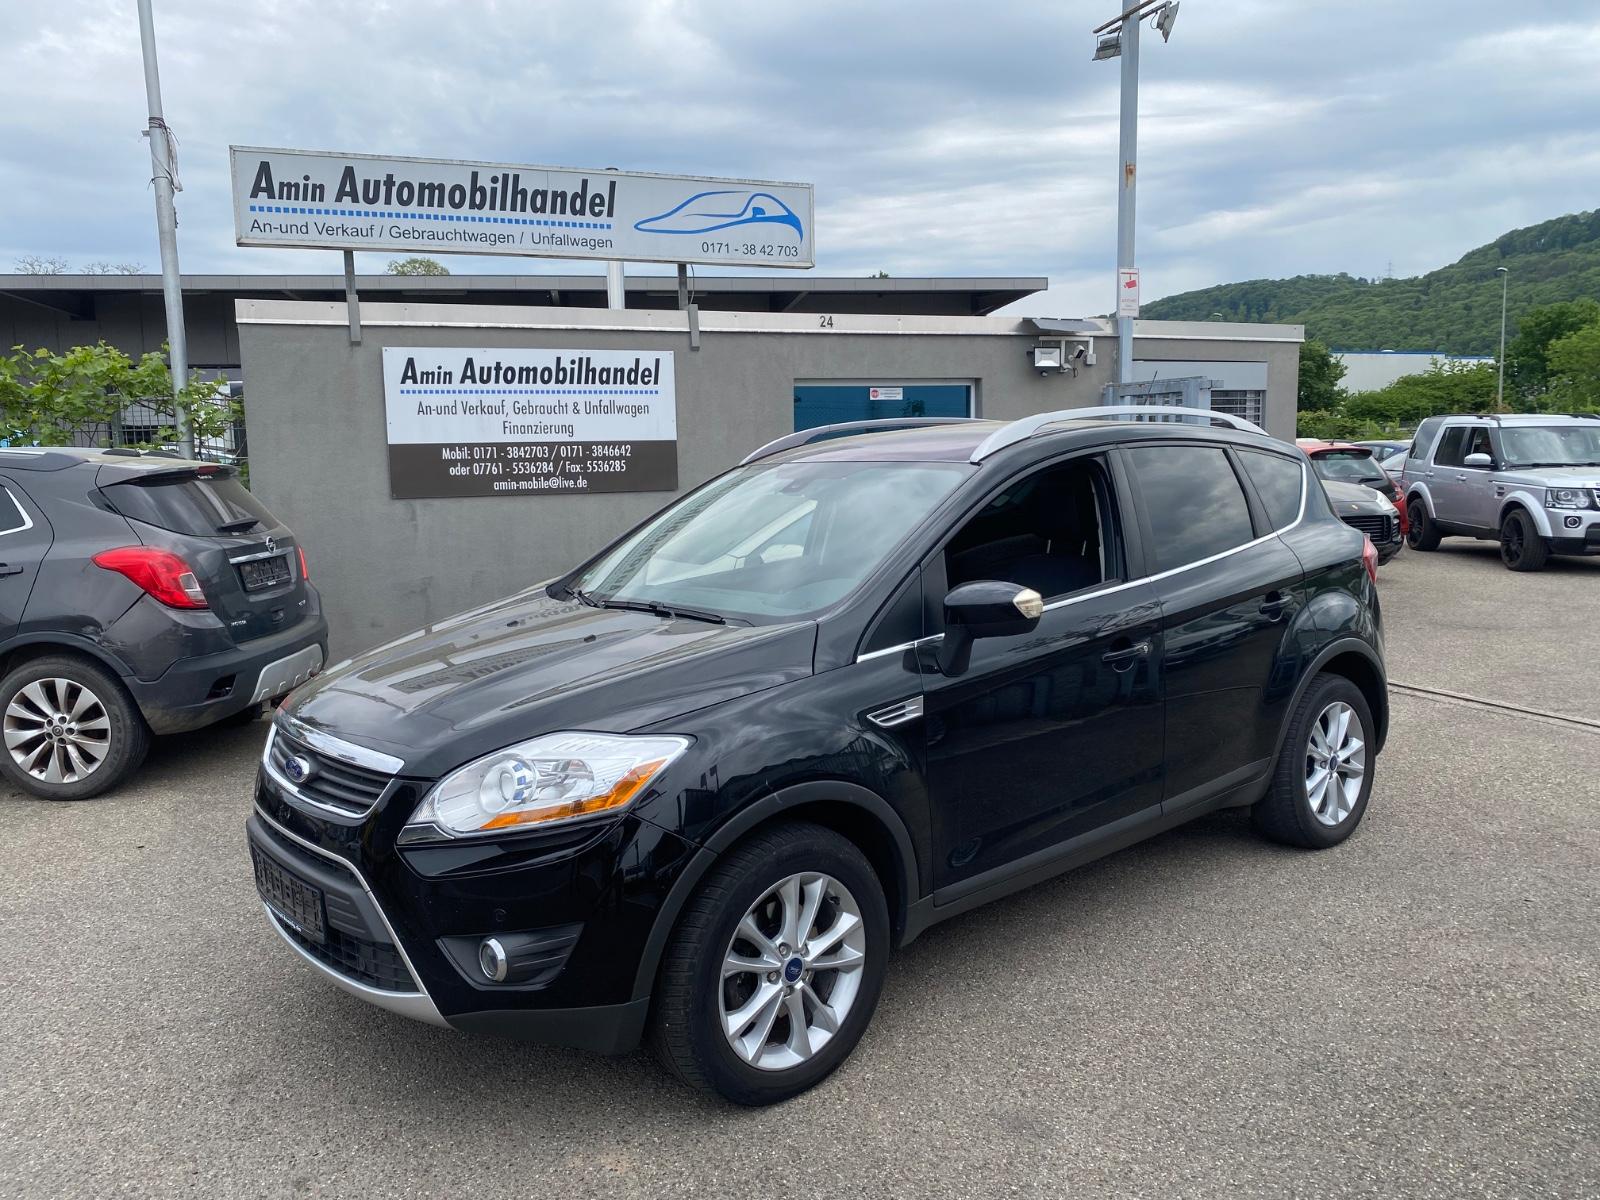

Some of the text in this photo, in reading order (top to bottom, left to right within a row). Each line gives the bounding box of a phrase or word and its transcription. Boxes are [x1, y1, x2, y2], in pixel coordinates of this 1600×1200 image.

[250, 161, 617, 218] Amin Automobilhandel
[250, 219, 613, 250] An-und Verkauf / Gebrauchtwagen / Unfallwagen
[701, 242, 729, 254] 0171
[742, 244, 756, 255] 38
[759, 245, 774, 256] 42
[777, 246, 798, 257] 703
[820, 315, 834, 328] 24
[400, 356, 660, 385] Amin Automobilhandel
[417, 400, 650, 417] An-und Verkauf, Gebraucht & Unfallwagen
[503, 421, 574, 437] Finanzierung
[442, 446, 471, 460] Mobil:
[473, 447, 497, 459] 0171
[506, 446, 549, 459] 3842703
[551, 444, 558, 460] /
[560, 445, 583, 457] 0171
[591, 445, 632, 457] 3846642
[449, 462, 471, 476] oder
[473, 462, 503, 475] 07761
[512, 461, 554, 474] 5536284
[556, 460, 563, 476] /
[565, 461, 584, 473] Fax:
[586, 460, 626, 472] 5536285
[493, 475, 588, 490] amin-mobile@live.de
